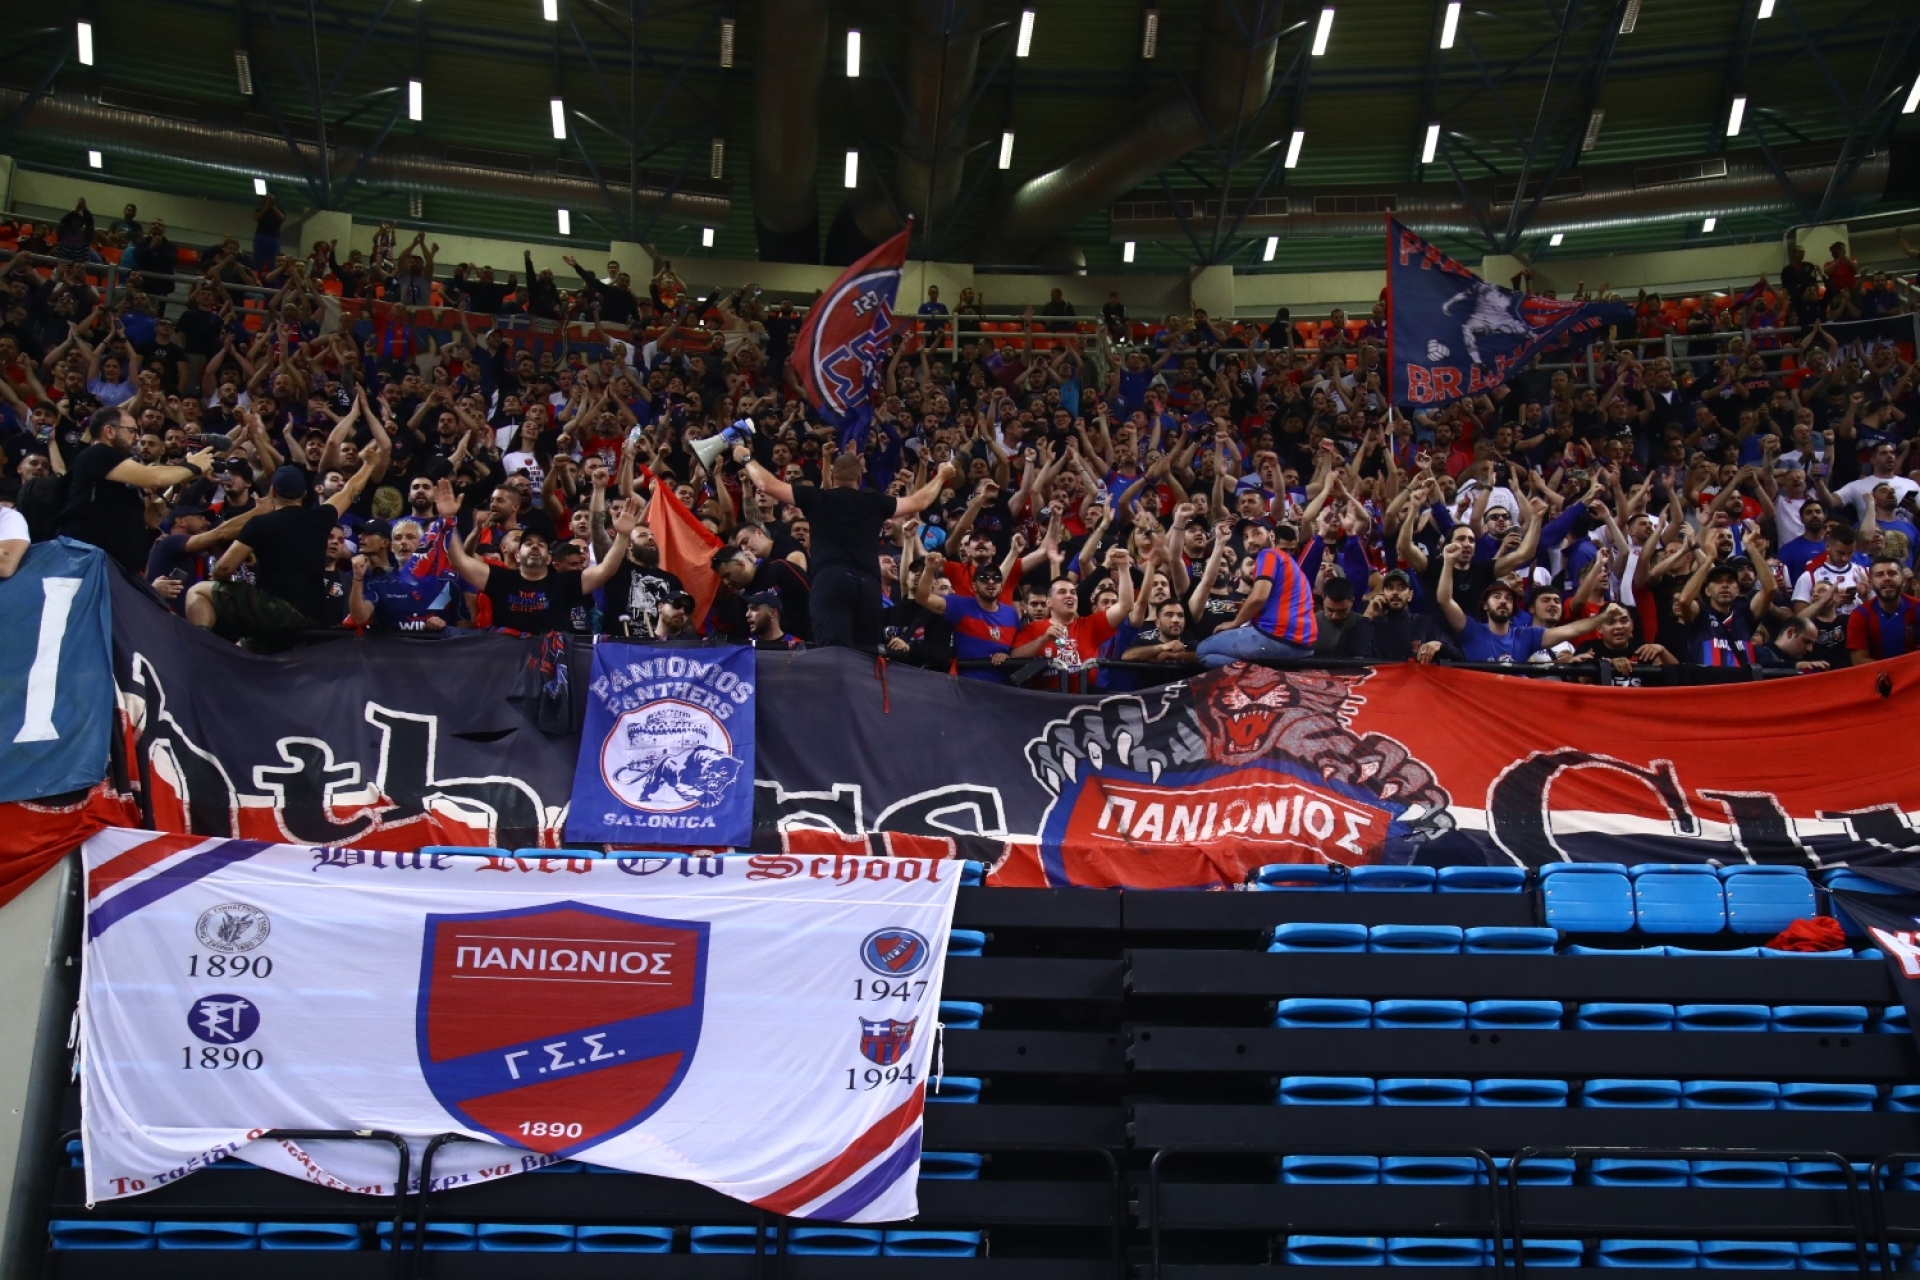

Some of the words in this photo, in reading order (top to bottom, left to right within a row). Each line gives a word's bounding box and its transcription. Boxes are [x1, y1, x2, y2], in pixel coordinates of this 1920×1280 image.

[589, 656, 755, 704] PANIONIOS
[605, 682, 735, 720] PANTHERS
[602, 813, 716, 829] SALONICA
[1097, 794, 1372, 856] ΠΑΝΙΩΝΙΟΣ
[187, 954, 273, 979] 1890
[456, 945, 672, 975] ΠΑΝΙΩΝΙΟΣ
[853, 978, 928, 1002] 1947
[182, 1046, 264, 1071] 1890
[504, 1032, 626, 1080] Γ.Σ.Σ.
[845, 1062, 916, 1091] 1994
[518, 1121, 582, 1139] 1890
[109, 1177, 146, 1195] Το
[478, 1163, 513, 1179] να
